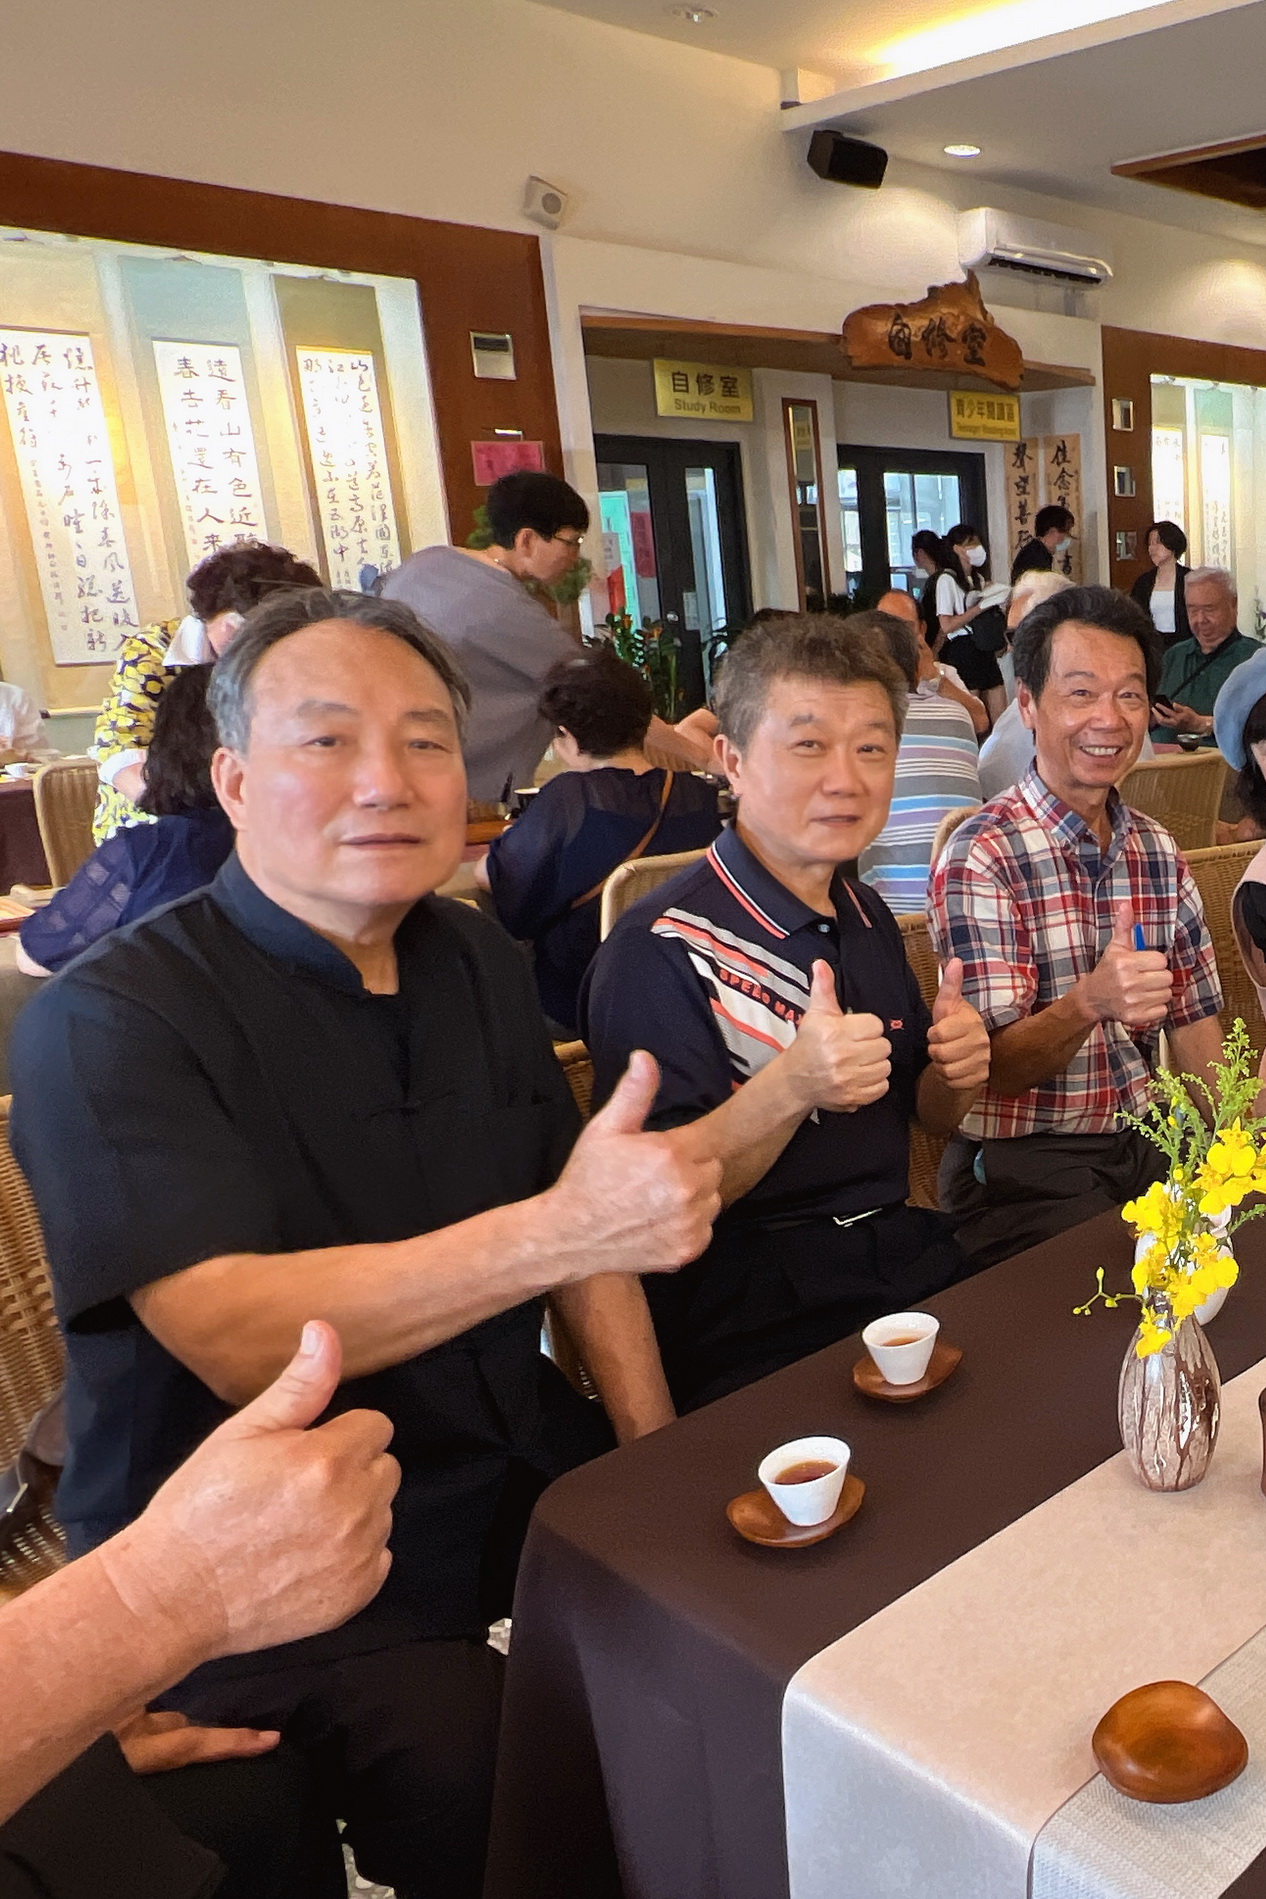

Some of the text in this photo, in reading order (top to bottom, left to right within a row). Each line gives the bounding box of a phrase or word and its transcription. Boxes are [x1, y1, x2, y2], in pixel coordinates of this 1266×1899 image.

[672, 371, 740, 398] 自修室
[674, 398, 741, 414] Study Room
